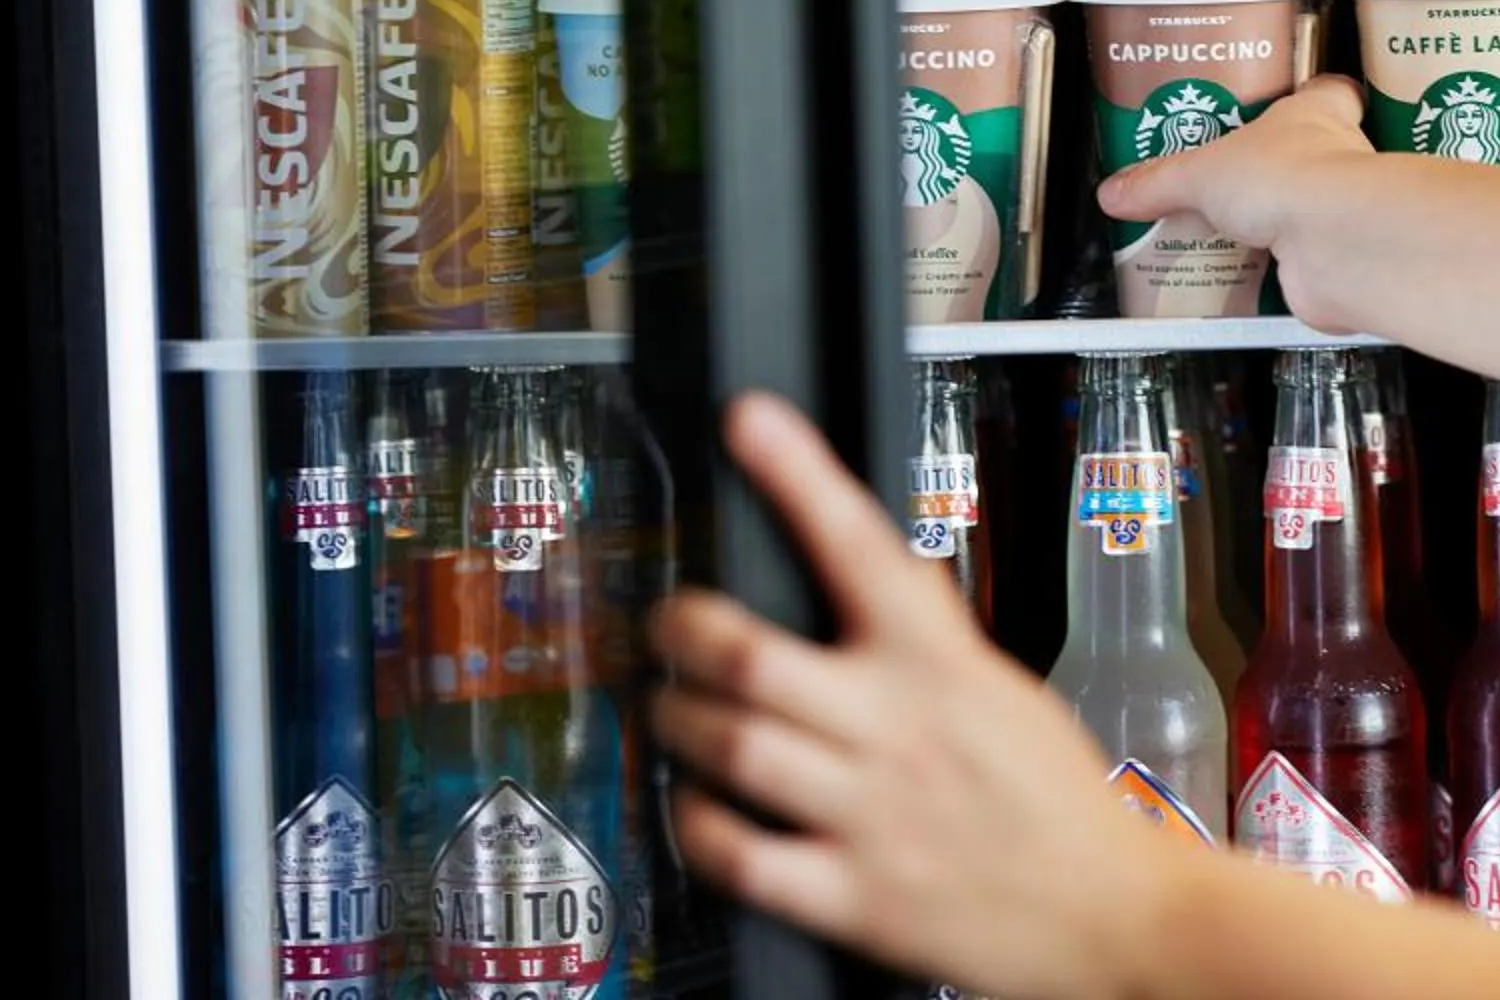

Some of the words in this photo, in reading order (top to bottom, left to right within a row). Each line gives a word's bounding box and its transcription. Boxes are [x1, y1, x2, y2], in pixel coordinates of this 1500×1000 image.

[1108, 39, 1273, 63] CAPPUCCINO
[1388, 31, 1463, 55] CAFFÈ
[912, 467, 970, 492] LITOS
[433, 885, 605, 942] SALITOS
